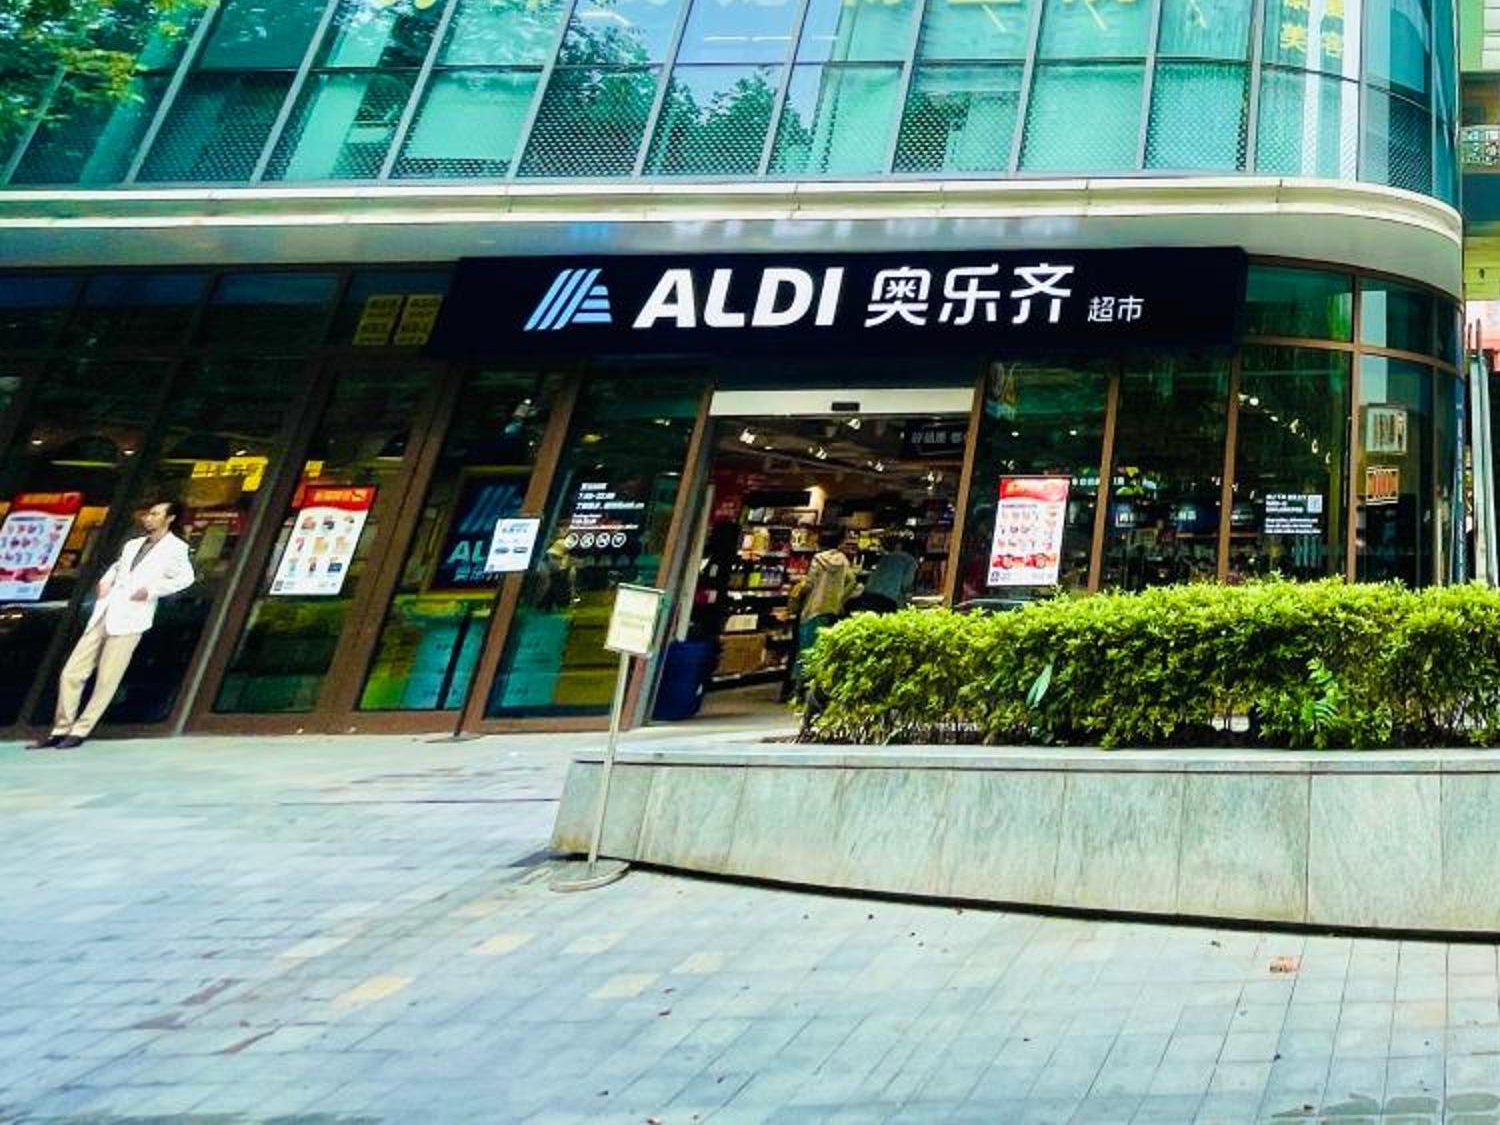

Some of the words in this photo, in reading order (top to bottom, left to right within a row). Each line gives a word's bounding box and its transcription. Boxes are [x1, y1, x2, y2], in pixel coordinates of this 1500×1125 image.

[631, 266, 846, 329] ALDI
[863, 262, 1076, 328] 奥乐齐
[1086, 295, 1146, 323] 超市
